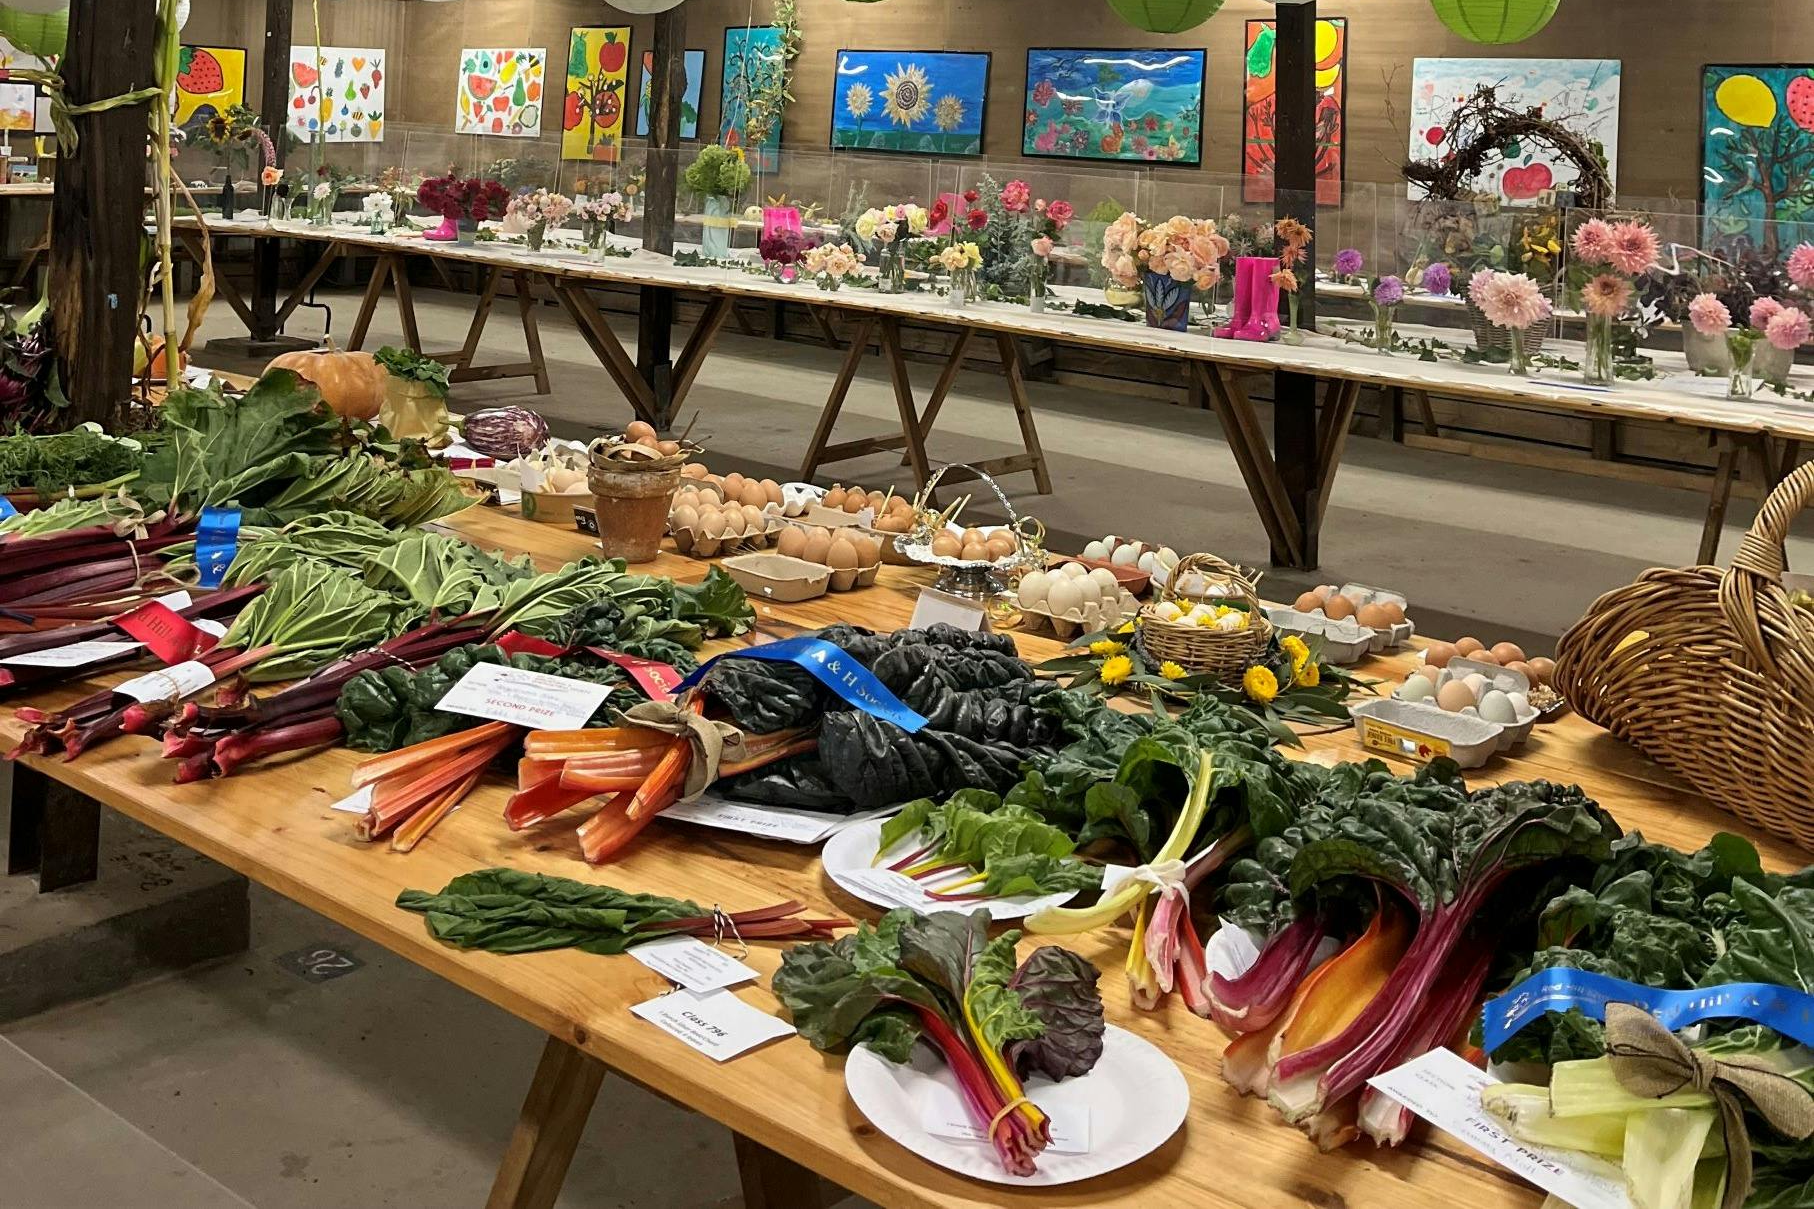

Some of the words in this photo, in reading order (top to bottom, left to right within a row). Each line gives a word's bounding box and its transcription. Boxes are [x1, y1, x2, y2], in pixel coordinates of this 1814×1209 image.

[811, 649, 827, 664] A
[827, 660, 841, 675] &
[842, 671, 858, 687] H
[485, 697, 527, 711] SECOND
[528, 705, 555, 718] PRIZE
[681, 1011, 709, 1027] Class
[1464, 1115, 1511, 1145] FIRST
[1515, 1146, 1567, 1177] PRIZE
